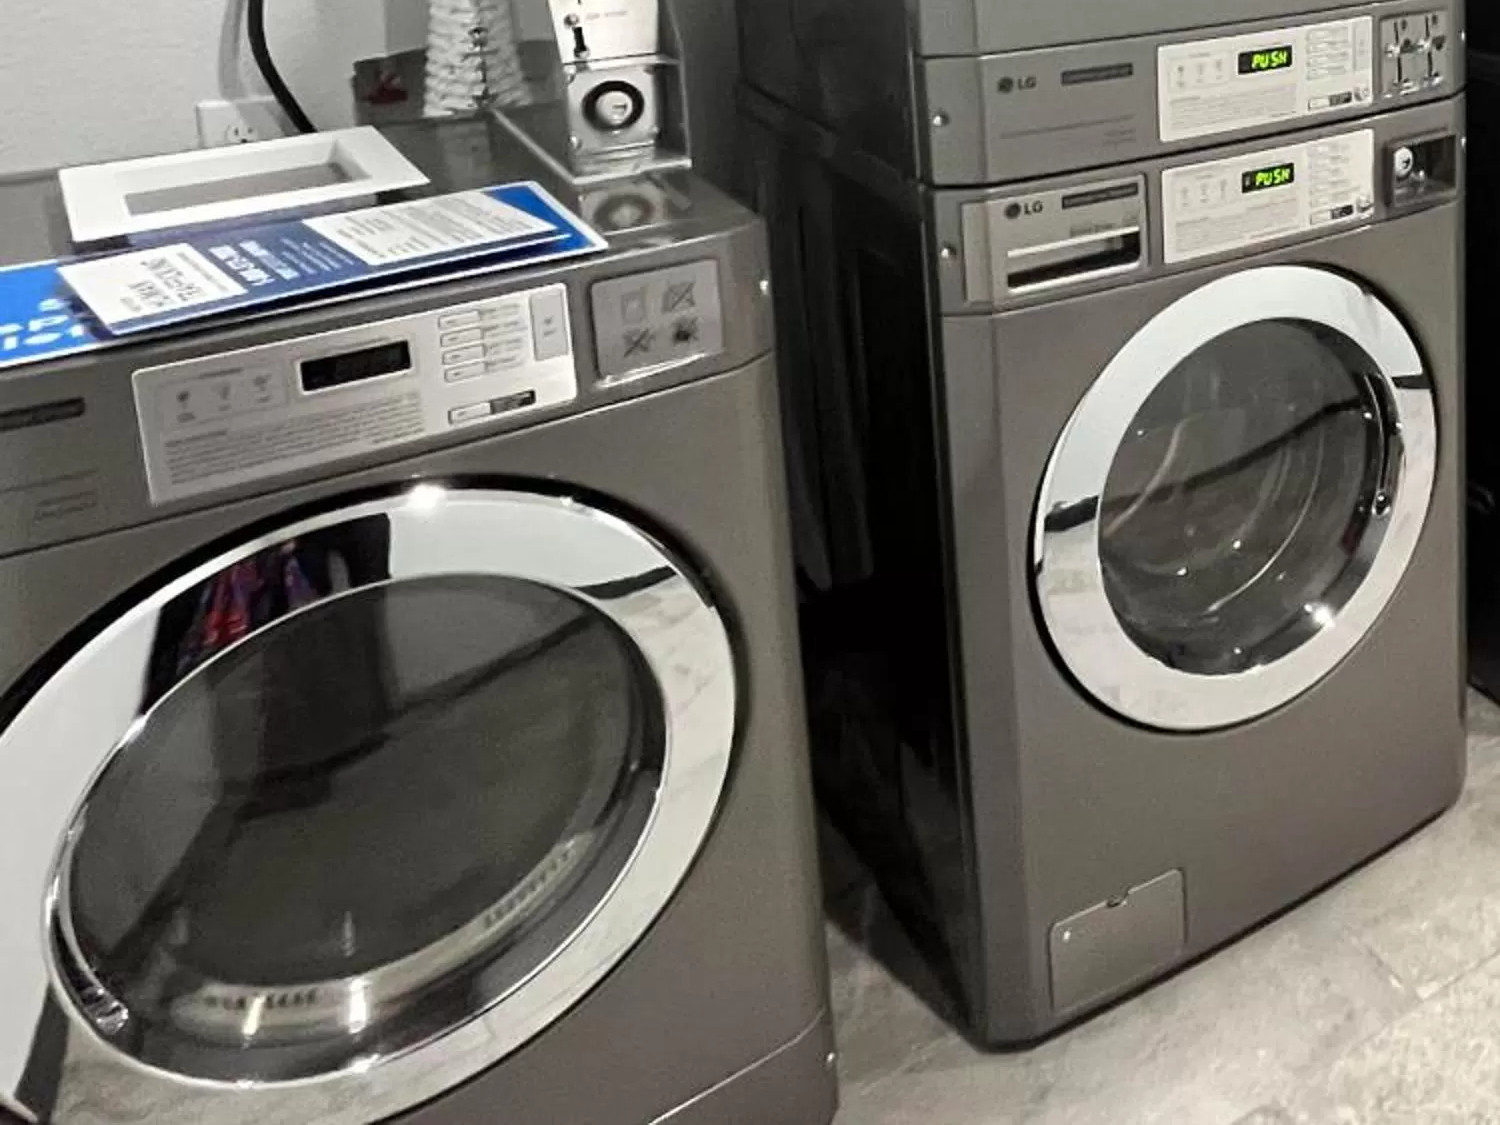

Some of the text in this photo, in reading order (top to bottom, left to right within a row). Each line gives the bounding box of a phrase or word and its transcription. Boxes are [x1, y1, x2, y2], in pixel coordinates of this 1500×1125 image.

[1251, 50, 1288, 69] PUSH
[1018, 76, 1037, 91] LG
[1255, 168, 1291, 187] PUSH
[1024, 200, 1044, 216] LG
